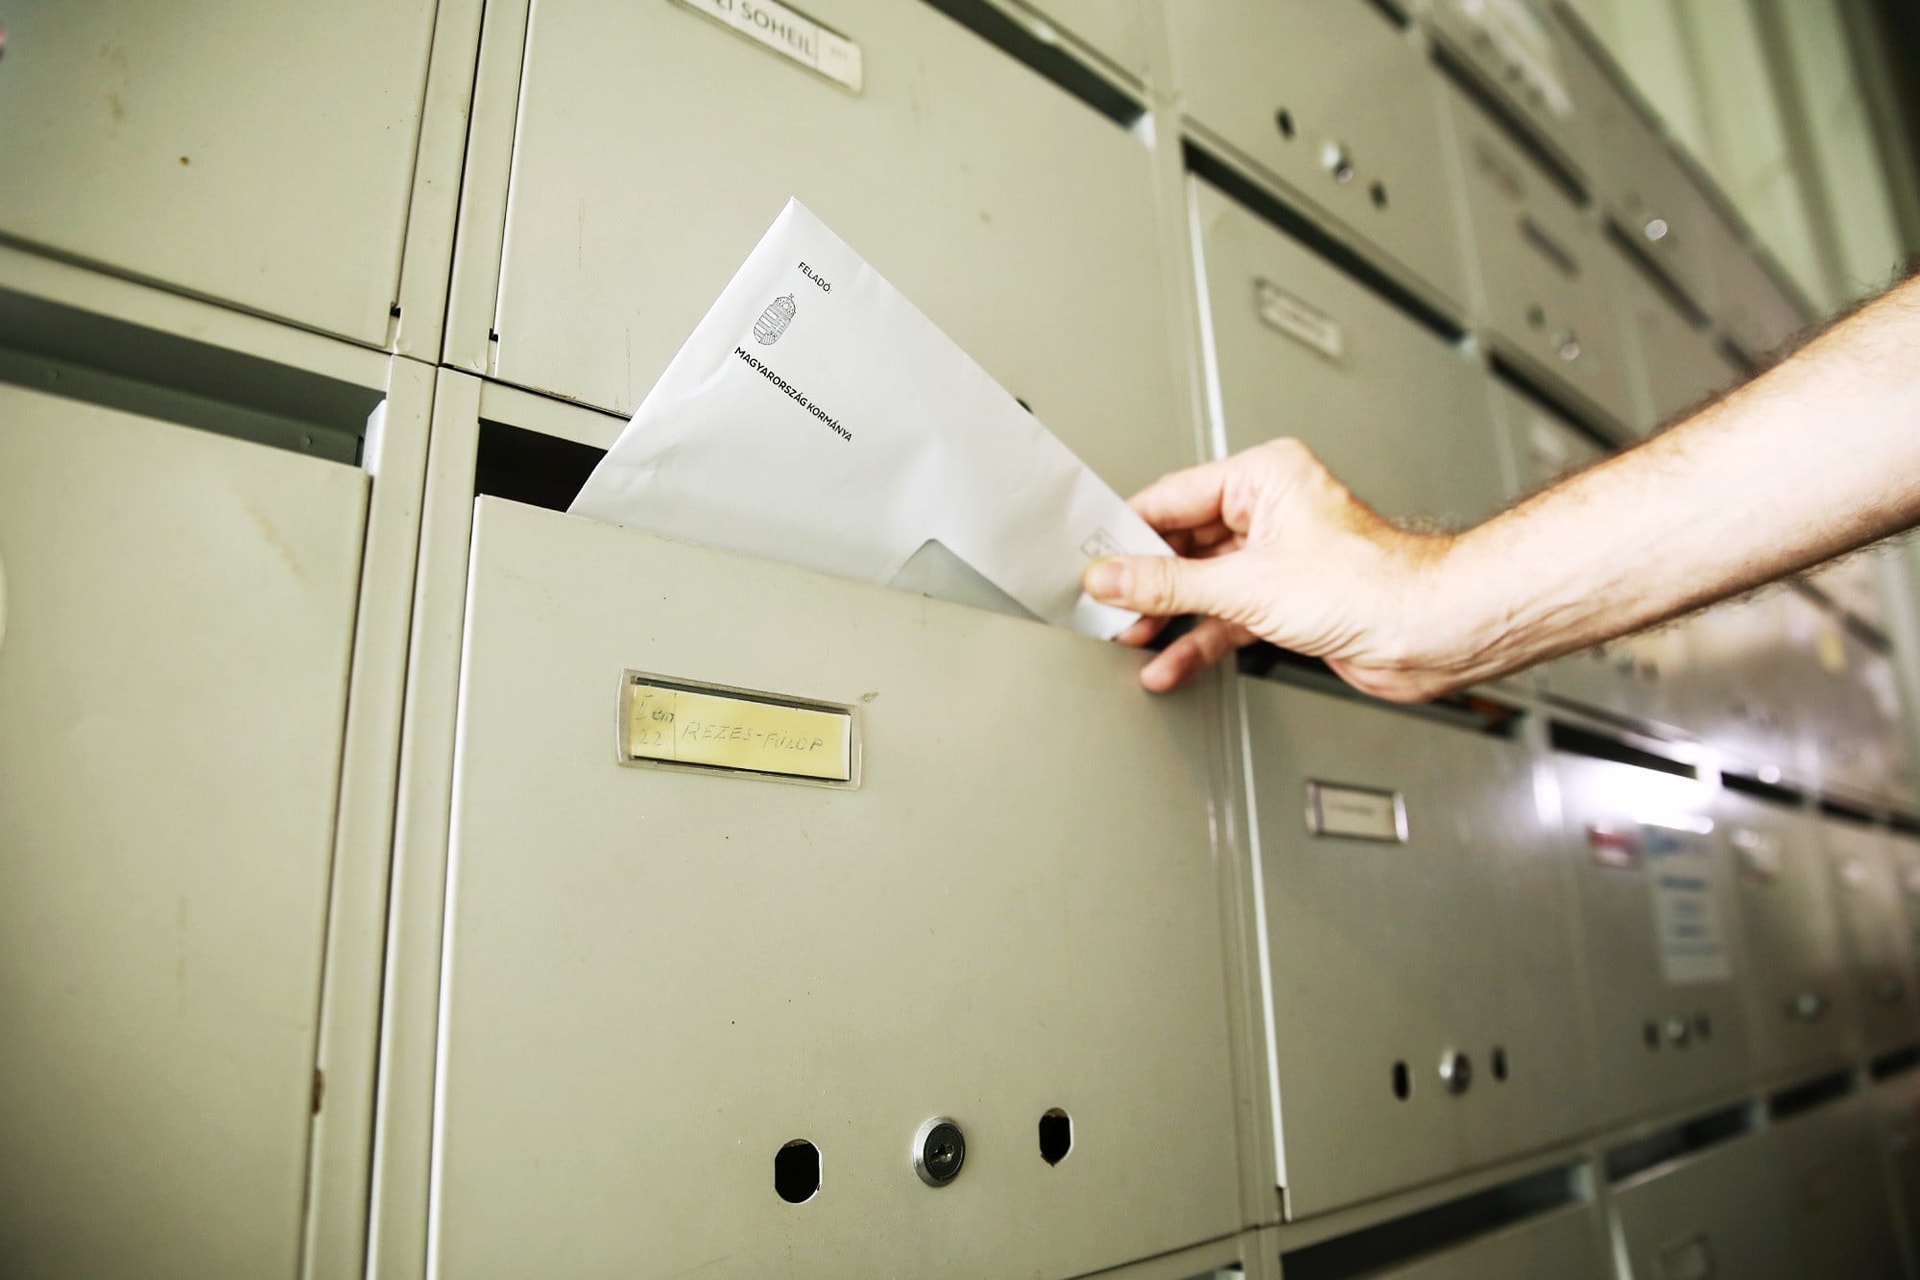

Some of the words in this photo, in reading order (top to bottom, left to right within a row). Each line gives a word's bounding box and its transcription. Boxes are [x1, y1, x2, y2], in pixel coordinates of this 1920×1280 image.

[741, 1, 816, 58] SOHEIL
[797, 261, 833, 295] FELADÓ:
[734, 346, 809, 408] MAGYARORSZÁG
[806, 402, 853, 442] KORMÁNYA
